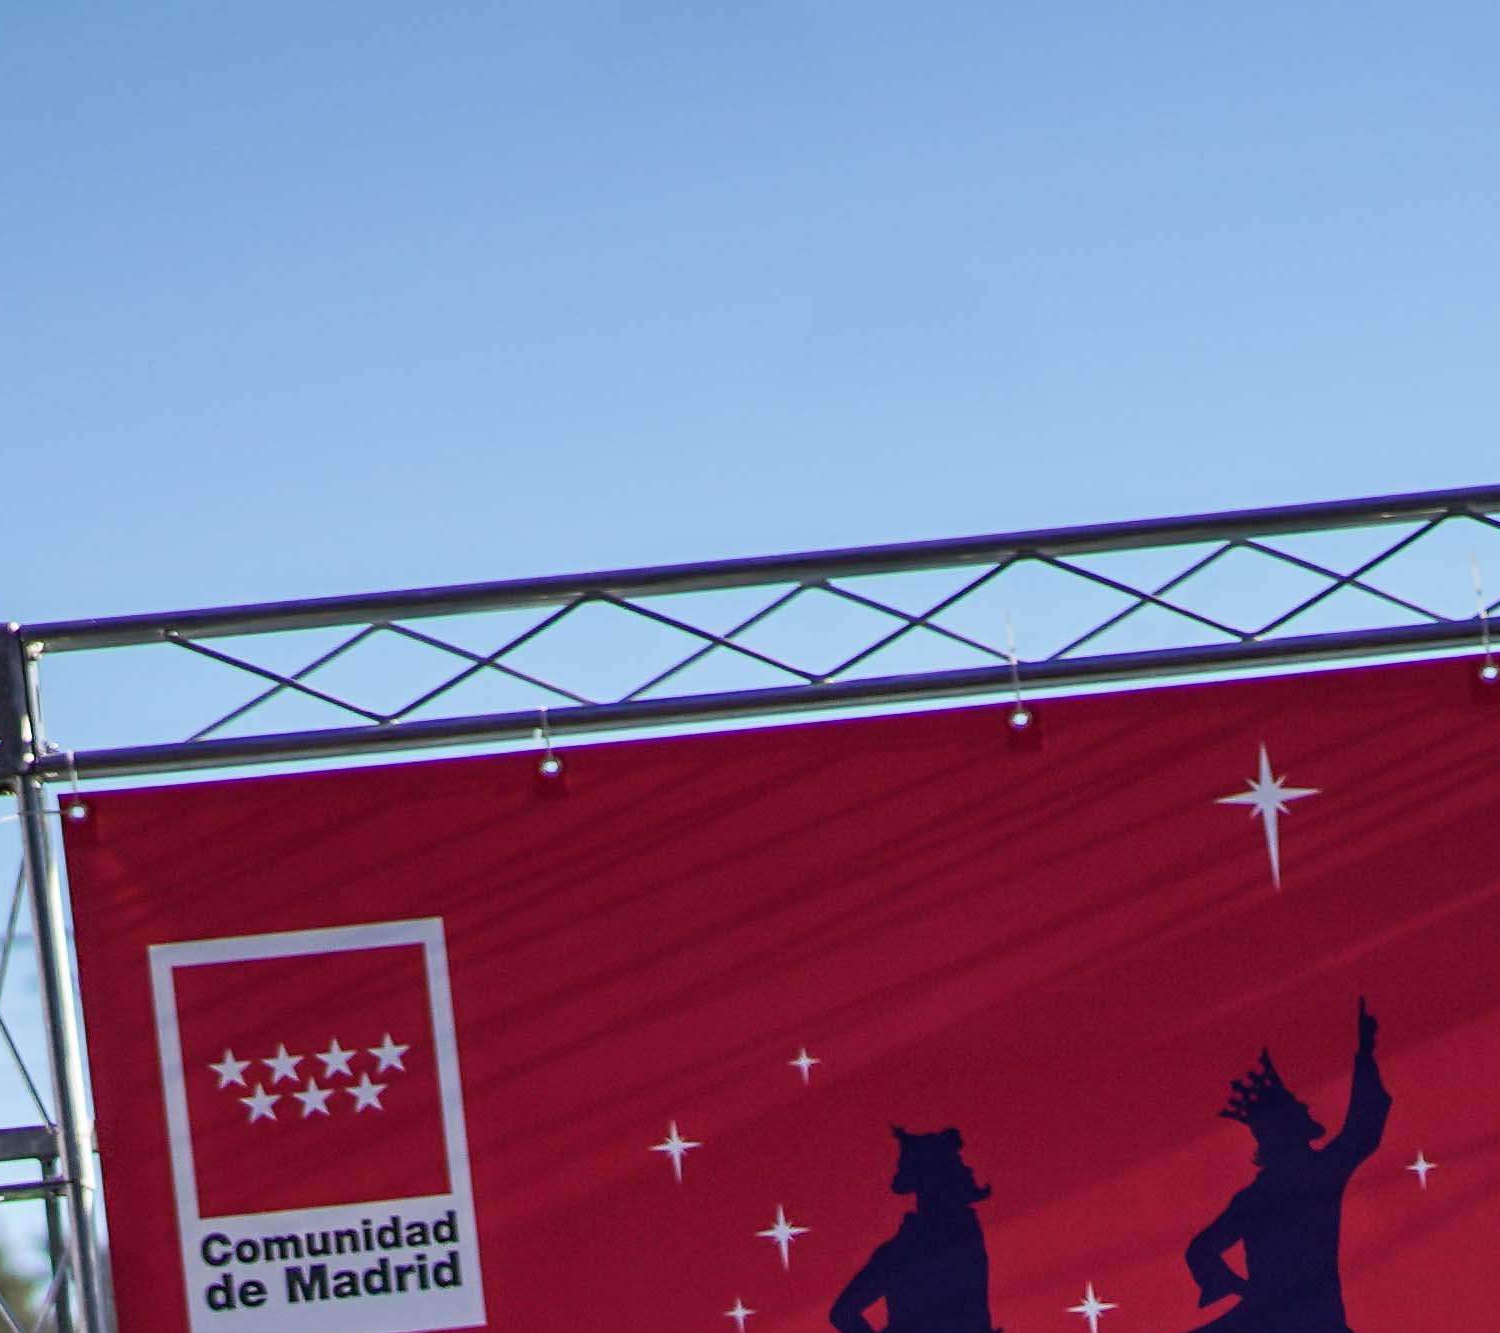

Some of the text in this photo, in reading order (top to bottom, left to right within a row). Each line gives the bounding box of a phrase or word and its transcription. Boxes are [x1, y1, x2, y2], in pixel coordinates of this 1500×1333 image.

[202, 1211, 459, 1267] Comunidad
[206, 1251, 463, 1312] de Madrid
